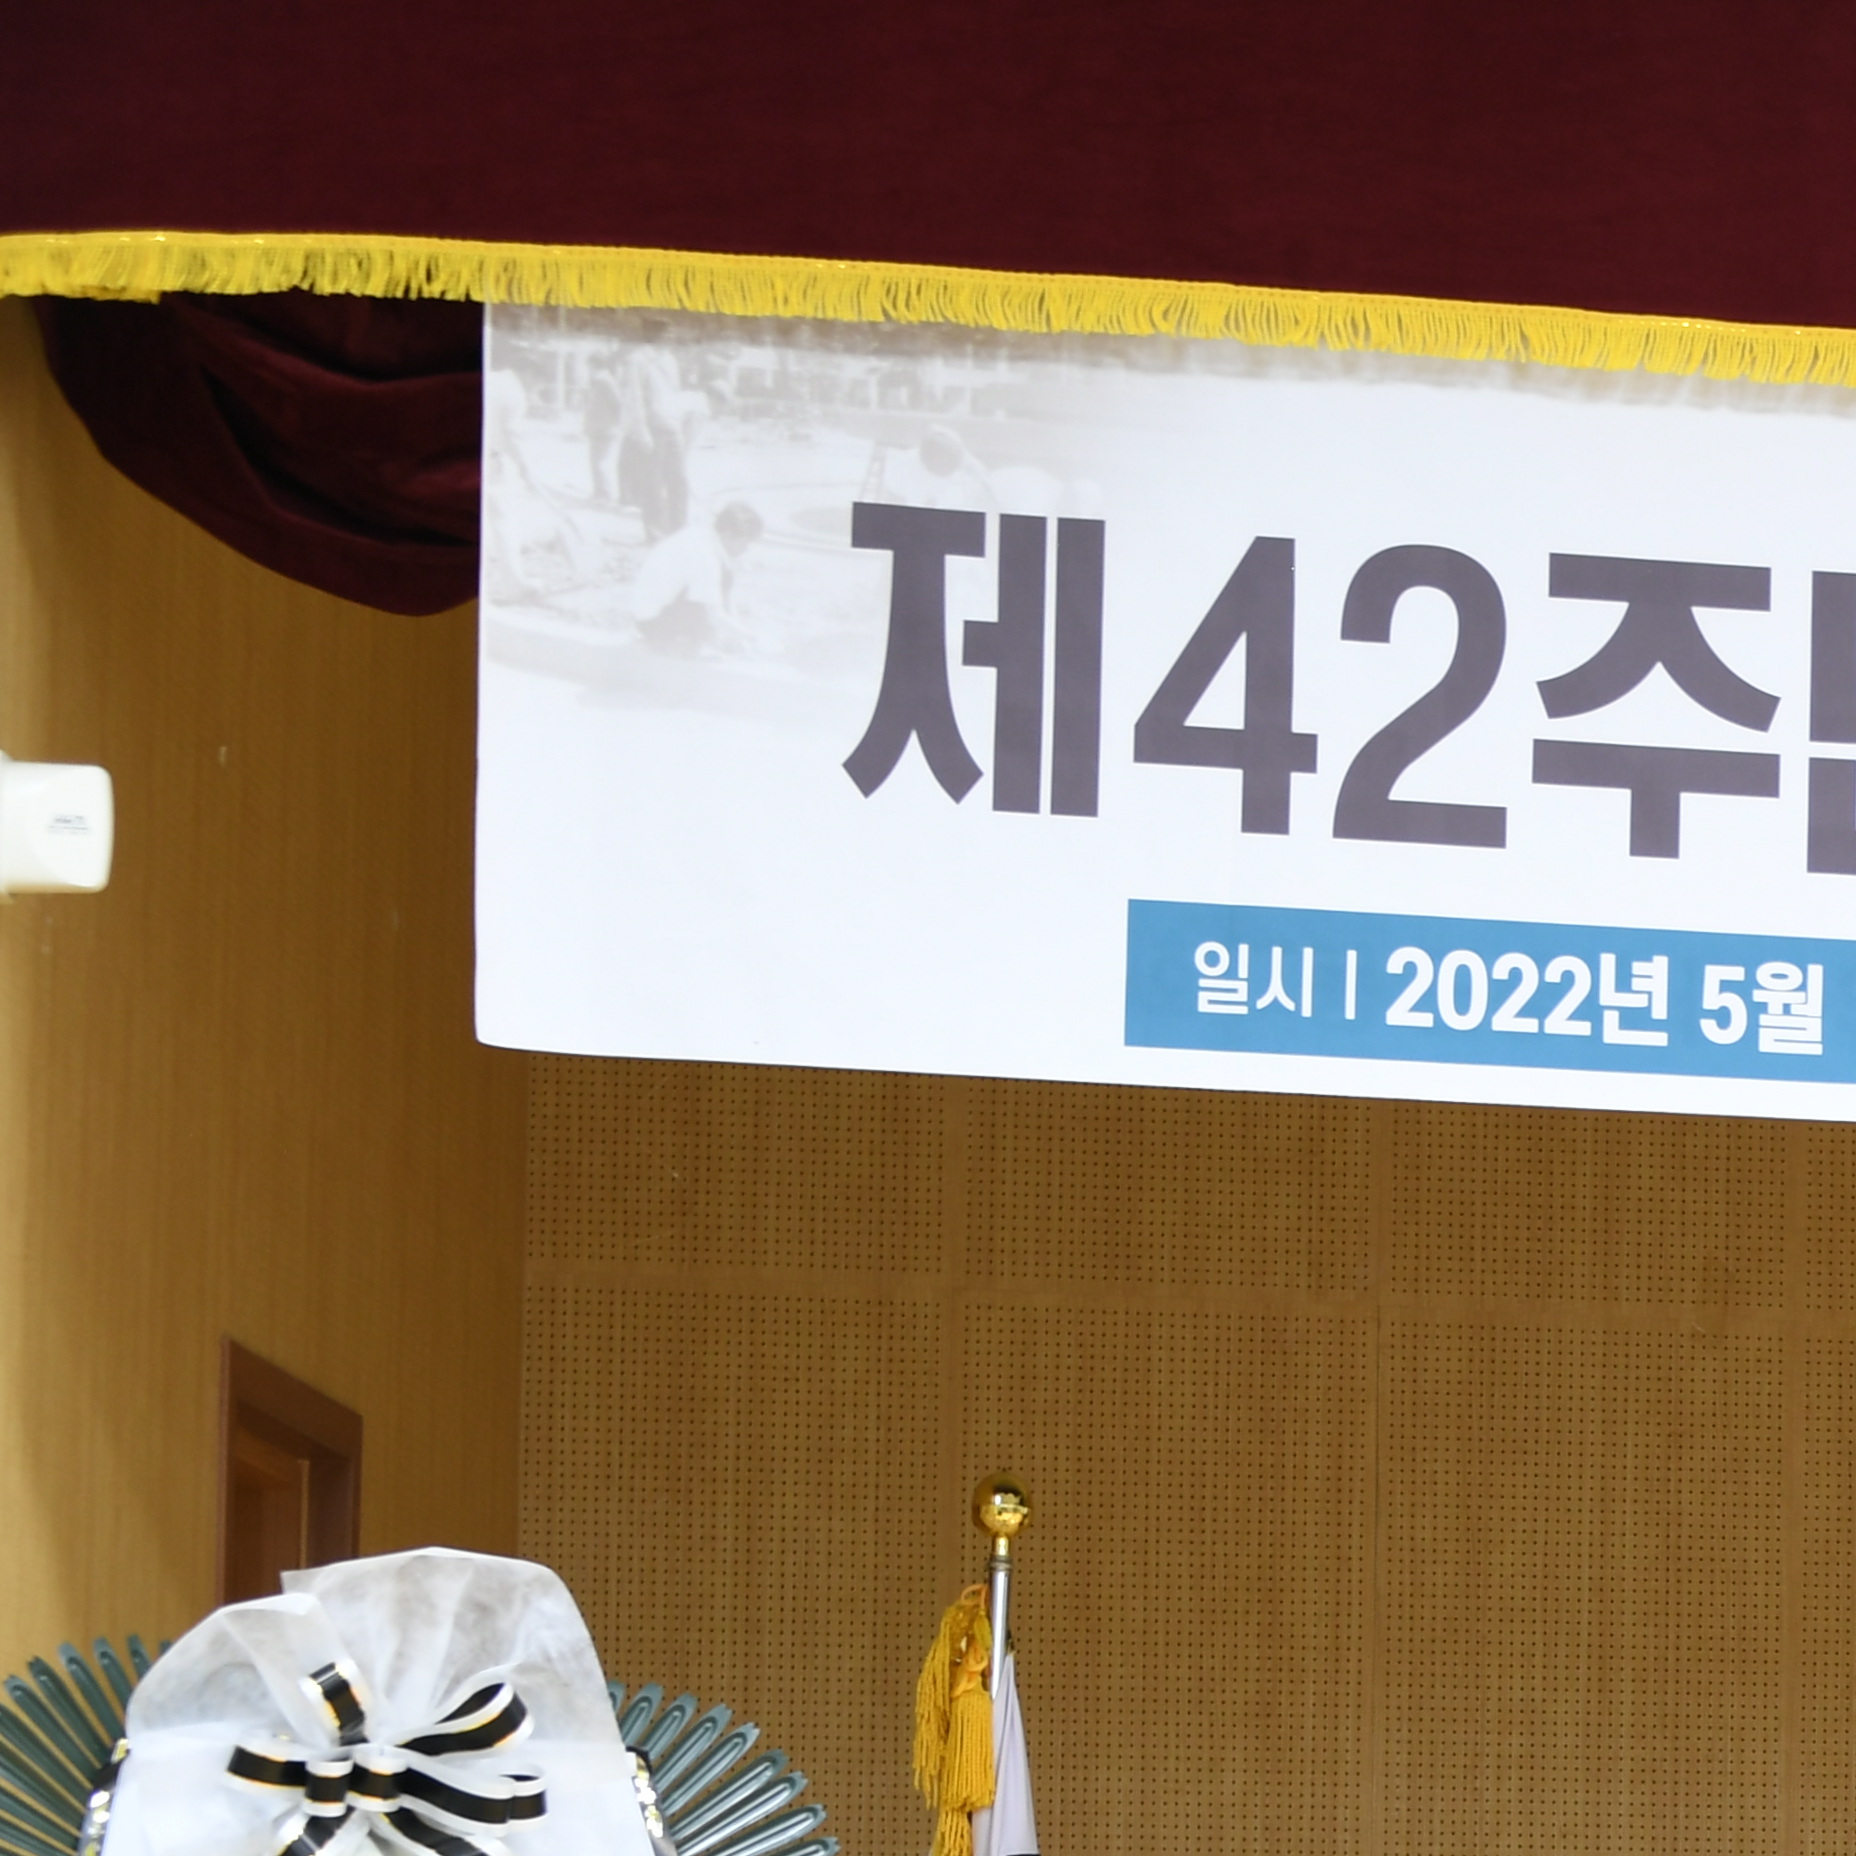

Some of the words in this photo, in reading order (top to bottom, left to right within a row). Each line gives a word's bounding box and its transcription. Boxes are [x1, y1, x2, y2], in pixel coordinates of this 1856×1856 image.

[1194, 941, 1314, 1018] 일시
[1385, 946, 1669, 1048] 2022년
[1699, 961, 1824, 1056] 5월
